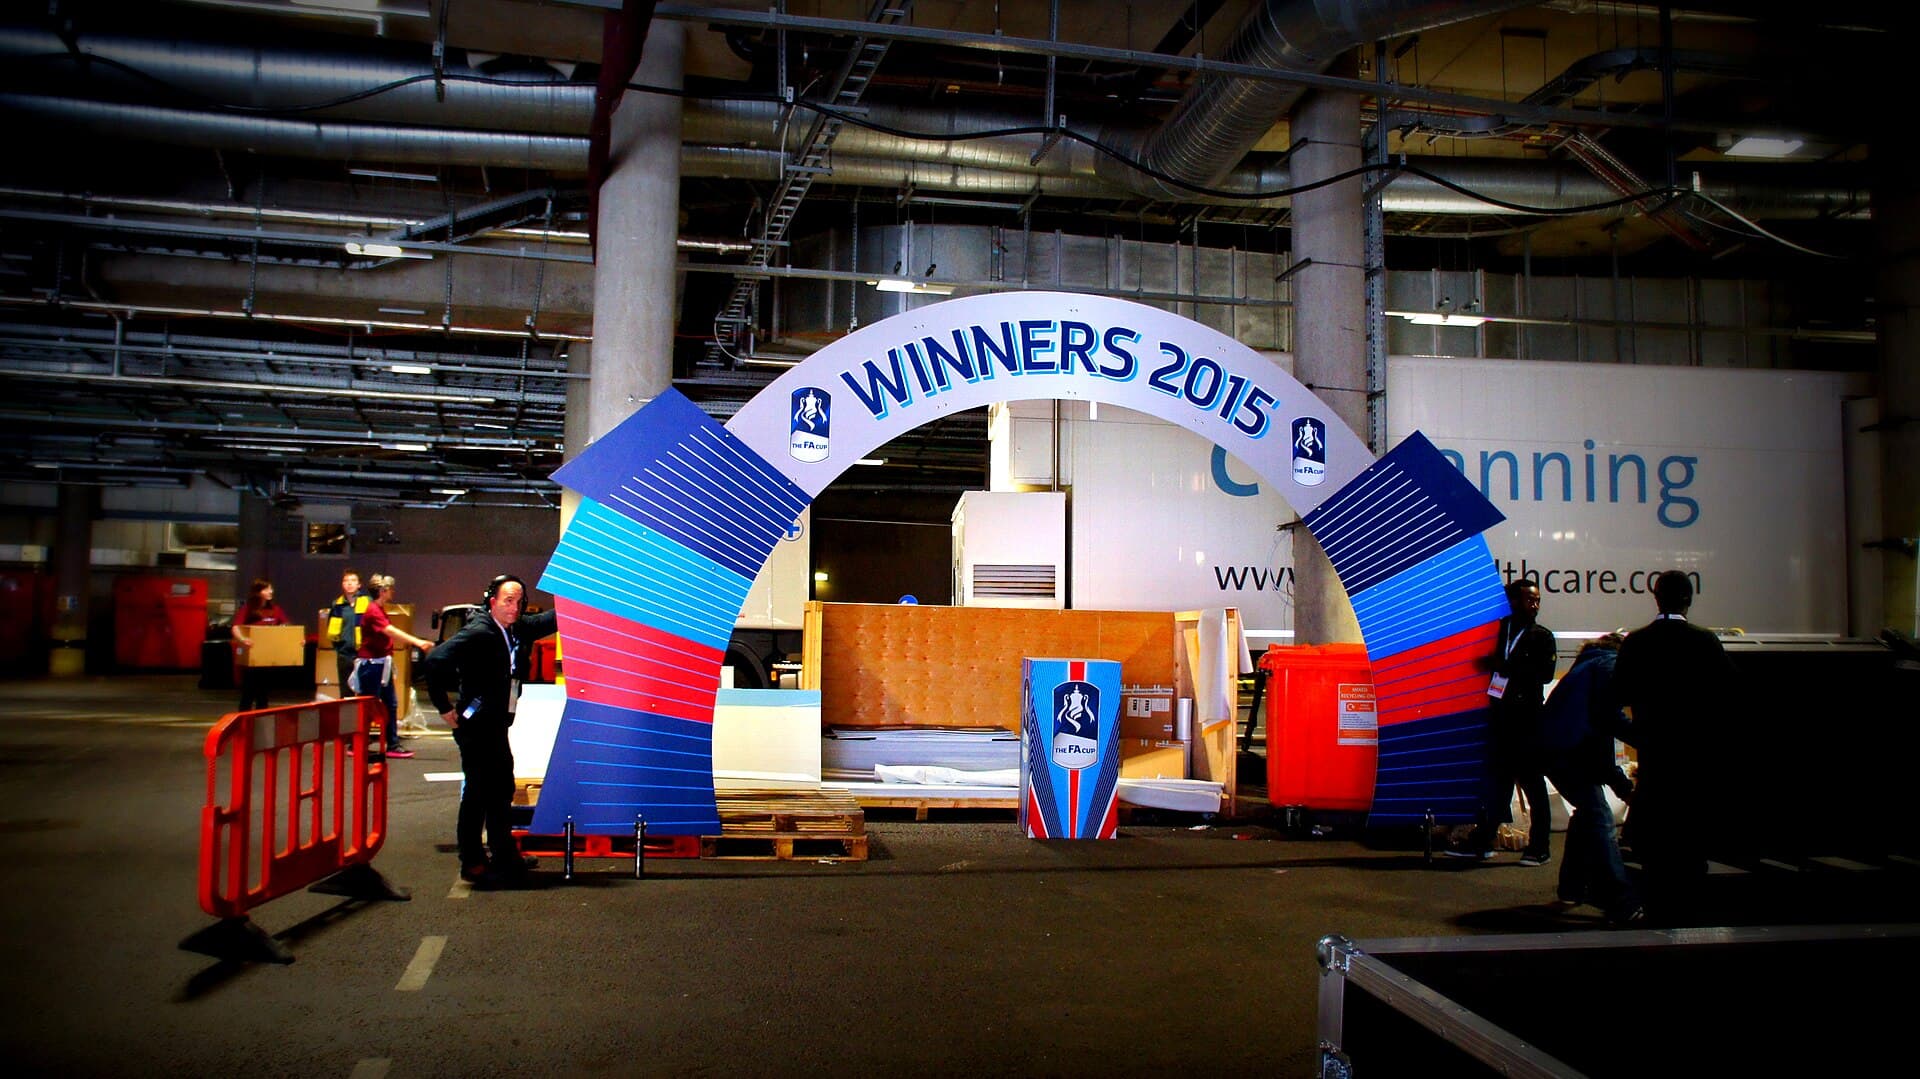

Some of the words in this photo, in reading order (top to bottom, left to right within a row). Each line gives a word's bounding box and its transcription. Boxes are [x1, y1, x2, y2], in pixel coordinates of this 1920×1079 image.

[840, 320, 1140, 421] WINNERS
[1148, 341, 1280, 440] 2015
[803, 441, 815, 449] FA
[1303, 466, 1314, 474] FA
[1214, 566, 1295, 591] ww
[1068, 744, 1082, 754] FA
